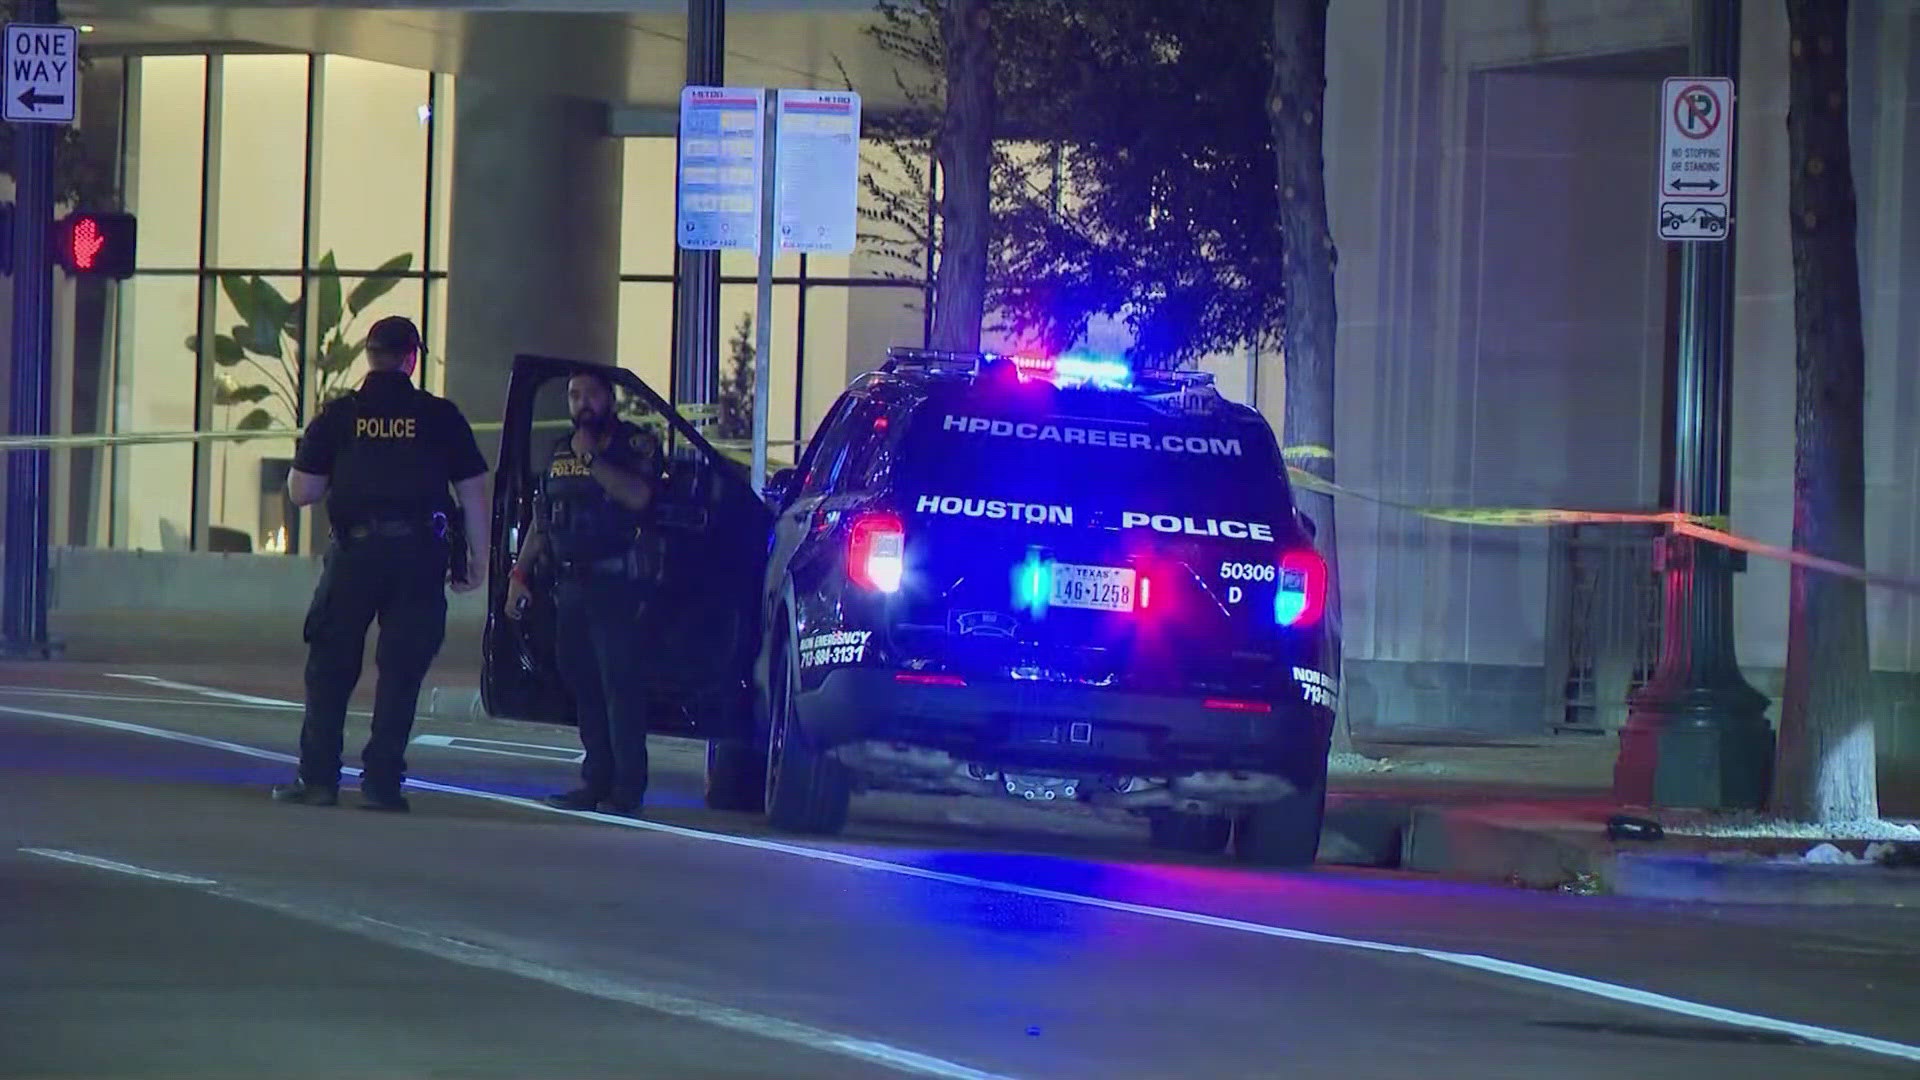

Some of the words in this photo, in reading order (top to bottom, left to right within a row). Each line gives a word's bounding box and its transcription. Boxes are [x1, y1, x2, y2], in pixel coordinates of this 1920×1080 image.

[16, 32, 66, 56] ONE
[14, 60, 67, 82] WAY
[1671, 147, 1682, 158] NO
[1685, 148, 1720, 158] STOPPING
[1671, 161, 1682, 172] OR
[1684, 161, 1720, 172] STANDING
[356, 418, 416, 438] POLICE
[943, 415, 1242, 456] HPDCAREER.COM
[551, 465, 591, 478] POLICE
[916, 495, 1073, 524] HOUSTON
[1122, 512, 1275, 542] POLICE
[1077, 568, 1109, 578] TEXAS
[1220, 562, 1275, 582] 50306
[1228, 587, 1242, 603] D
[815, 631, 872, 646] EMERGENCY
[1292, 666, 1321, 685] NON
